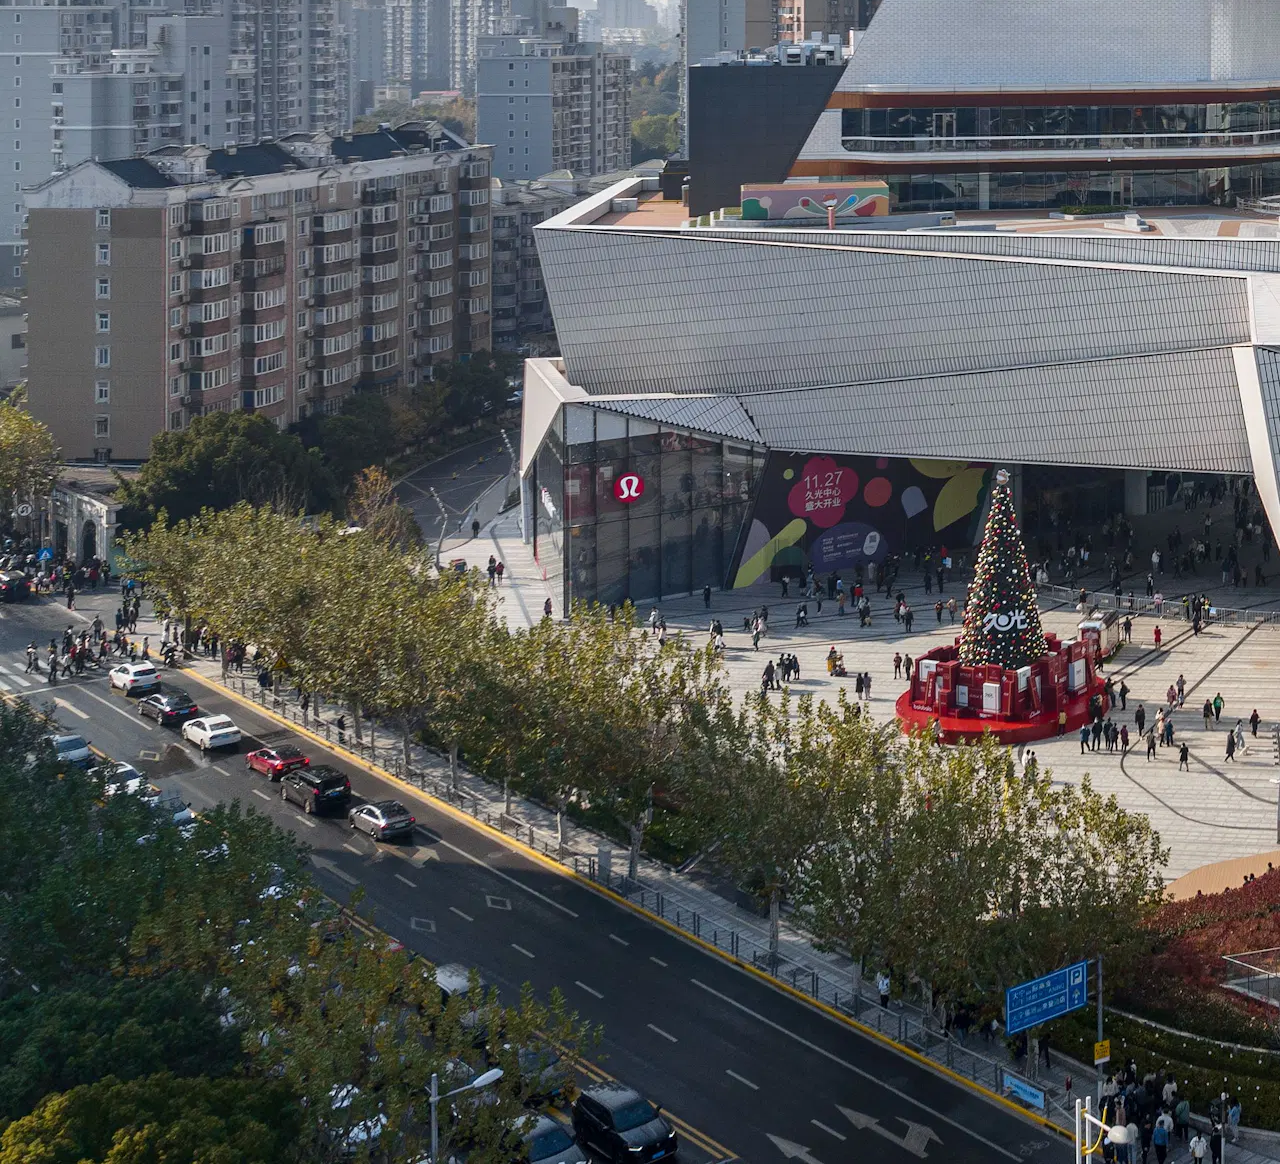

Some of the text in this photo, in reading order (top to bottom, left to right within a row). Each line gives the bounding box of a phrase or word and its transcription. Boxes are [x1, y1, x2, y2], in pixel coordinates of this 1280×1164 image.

[804, 471, 844, 490] 11.27
[805, 487, 841, 500] 久光中心
[805, 498, 841, 512] 盛大开业
[982, 609, 1029, 632] 久光
